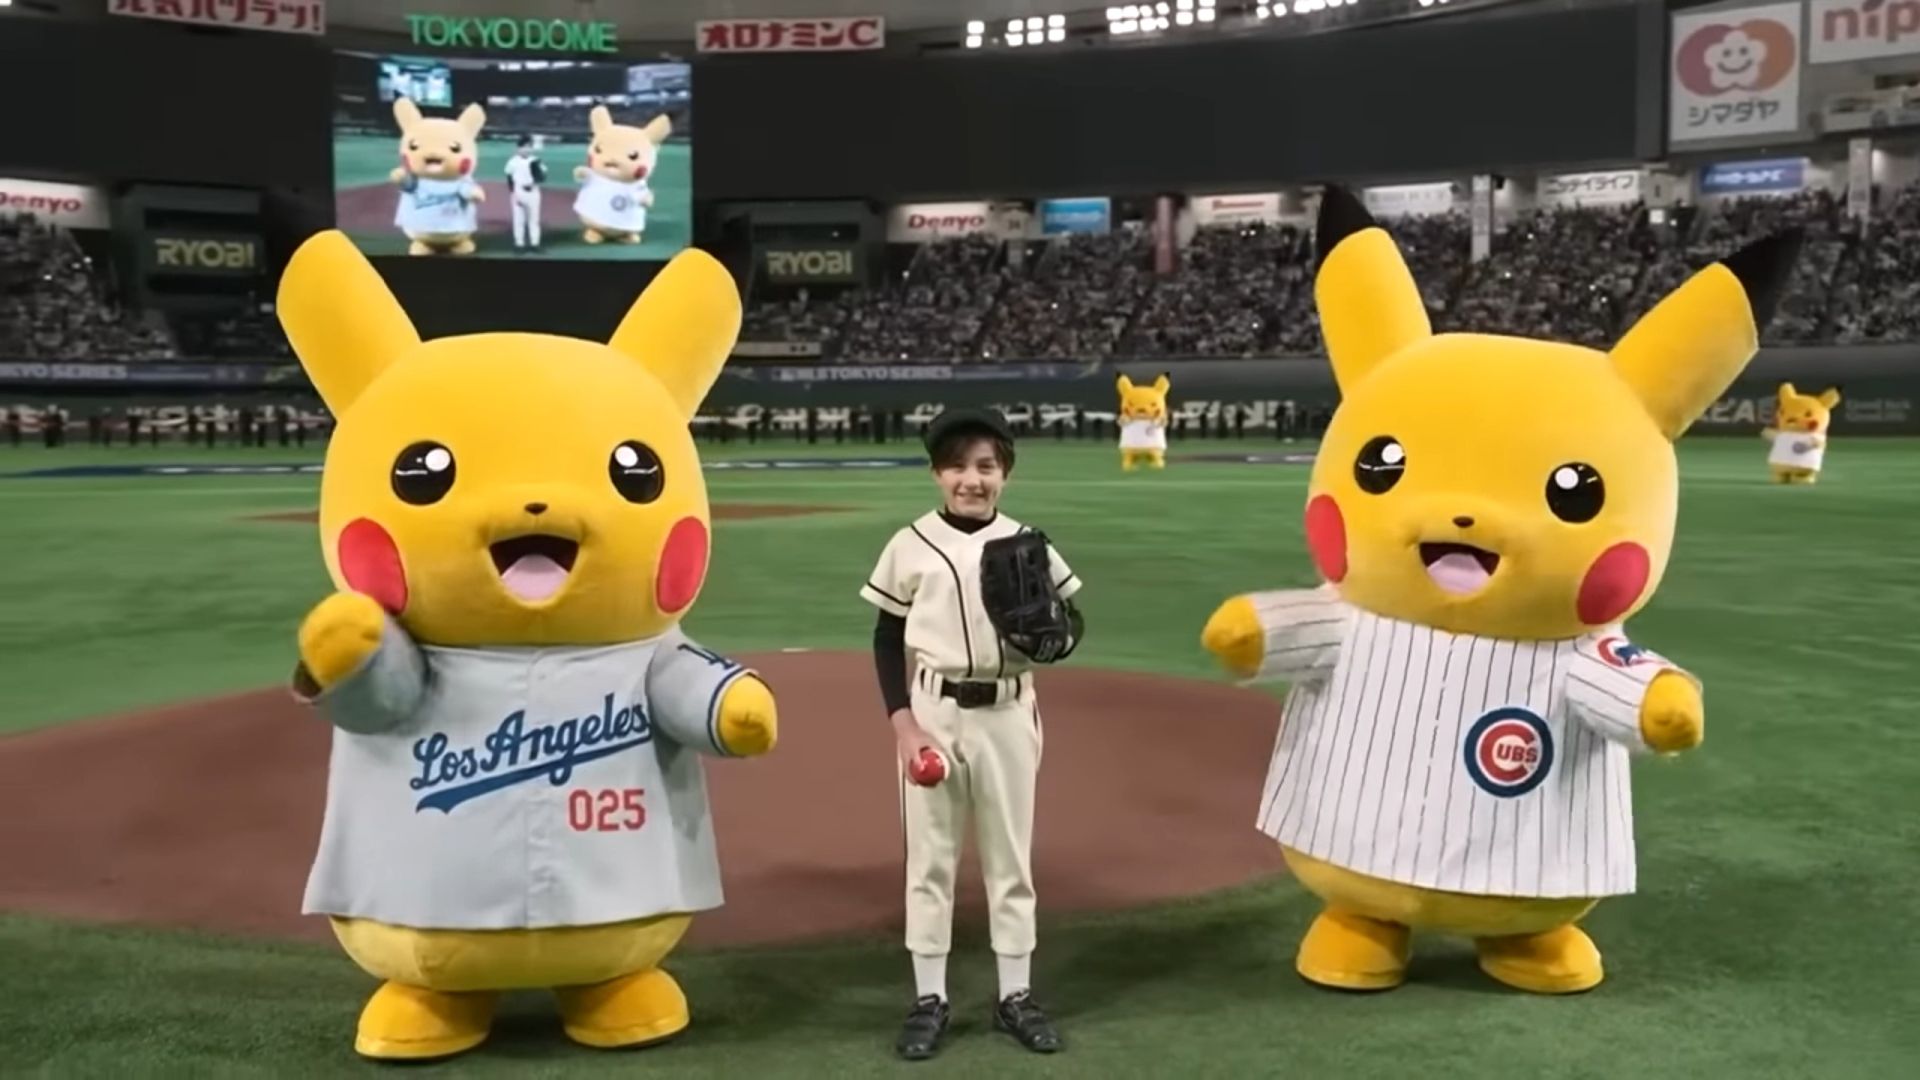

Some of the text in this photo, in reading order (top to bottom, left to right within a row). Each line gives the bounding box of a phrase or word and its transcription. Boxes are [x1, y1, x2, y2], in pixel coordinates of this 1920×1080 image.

[407, 15, 617, 51] TOKYO DOME
[703, 20, 879, 48] オロナミンC
[1688, 100, 1779, 127] シマダヤ
[0, 191, 81, 214] enyo
[908, 213, 984, 230] Denyo
[155, 238, 255, 268] RYOBI
[766, 251, 853, 276] RYOBI
[410, 692, 651, 790] Los Angeles
[568, 789, 645, 831] 025
